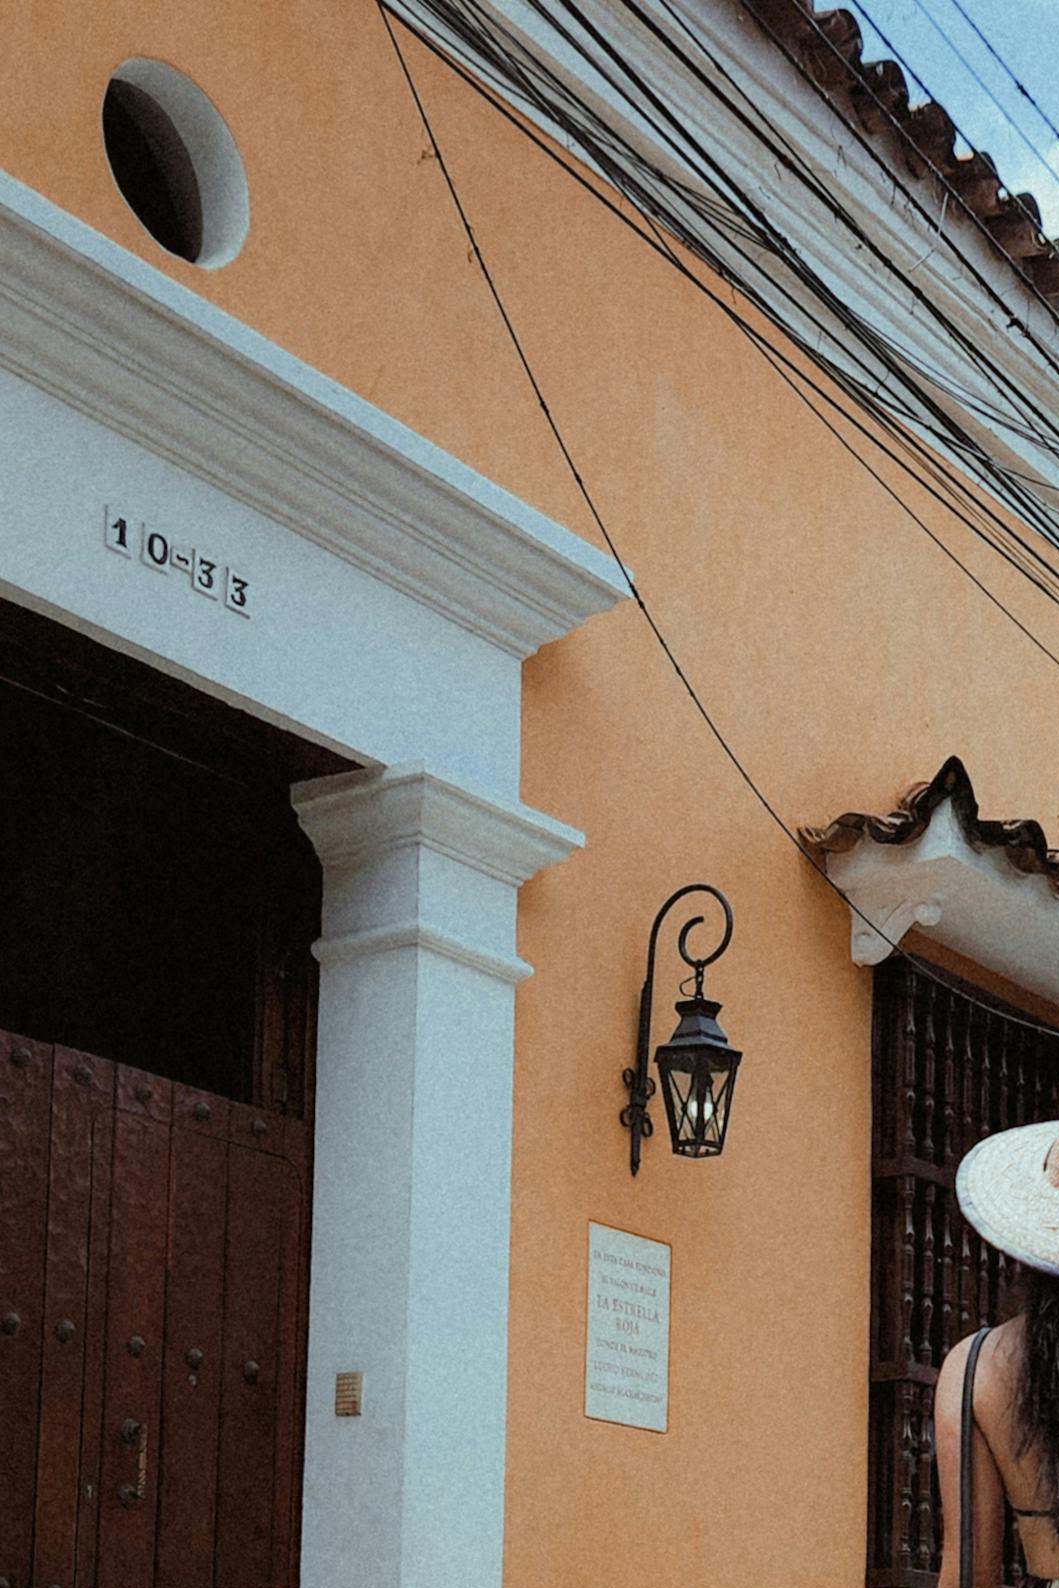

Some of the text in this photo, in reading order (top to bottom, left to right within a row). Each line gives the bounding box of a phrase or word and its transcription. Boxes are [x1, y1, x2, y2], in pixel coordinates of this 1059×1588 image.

[112, 517, 249, 607] 10-33
[596, 1294, 660, 1324] LA ESTRELLA
[615, 1317, 640, 1335] ROJA
